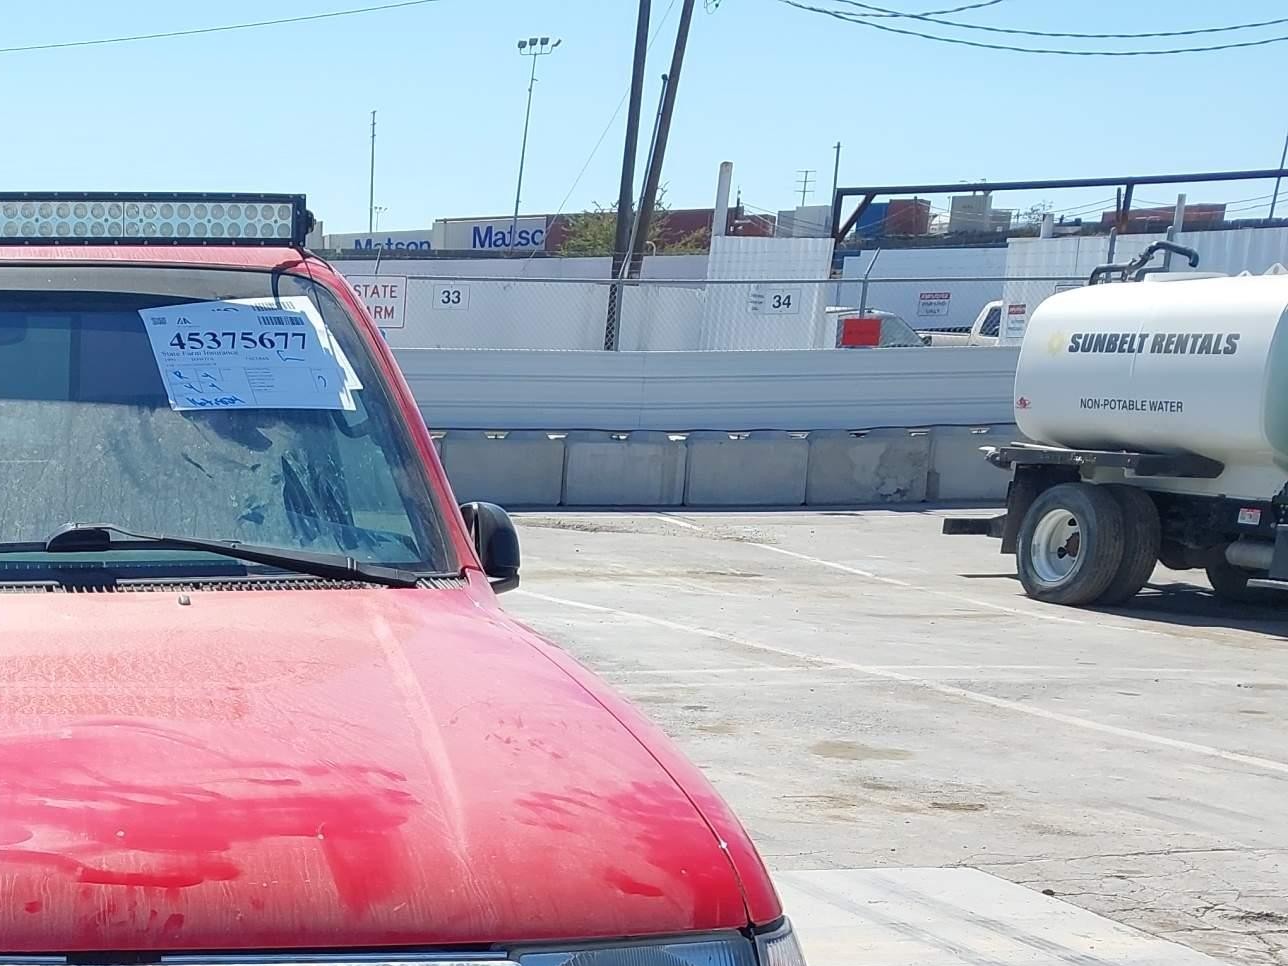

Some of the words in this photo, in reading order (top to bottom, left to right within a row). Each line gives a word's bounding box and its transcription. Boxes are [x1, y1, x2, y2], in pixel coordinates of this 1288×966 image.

[353, 284, 398, 299] STATE
[441, 290, 461, 304] 33
[772, 294, 791, 309] 34
[169, 331, 307, 350] 45375677
[1068, 333, 1149, 353] SUNBELT
[1150, 333, 1240, 354] RENTALS
[1079, 398, 1147, 411] NON-POTABLE
[1149, 401, 1183, 412] WATER
